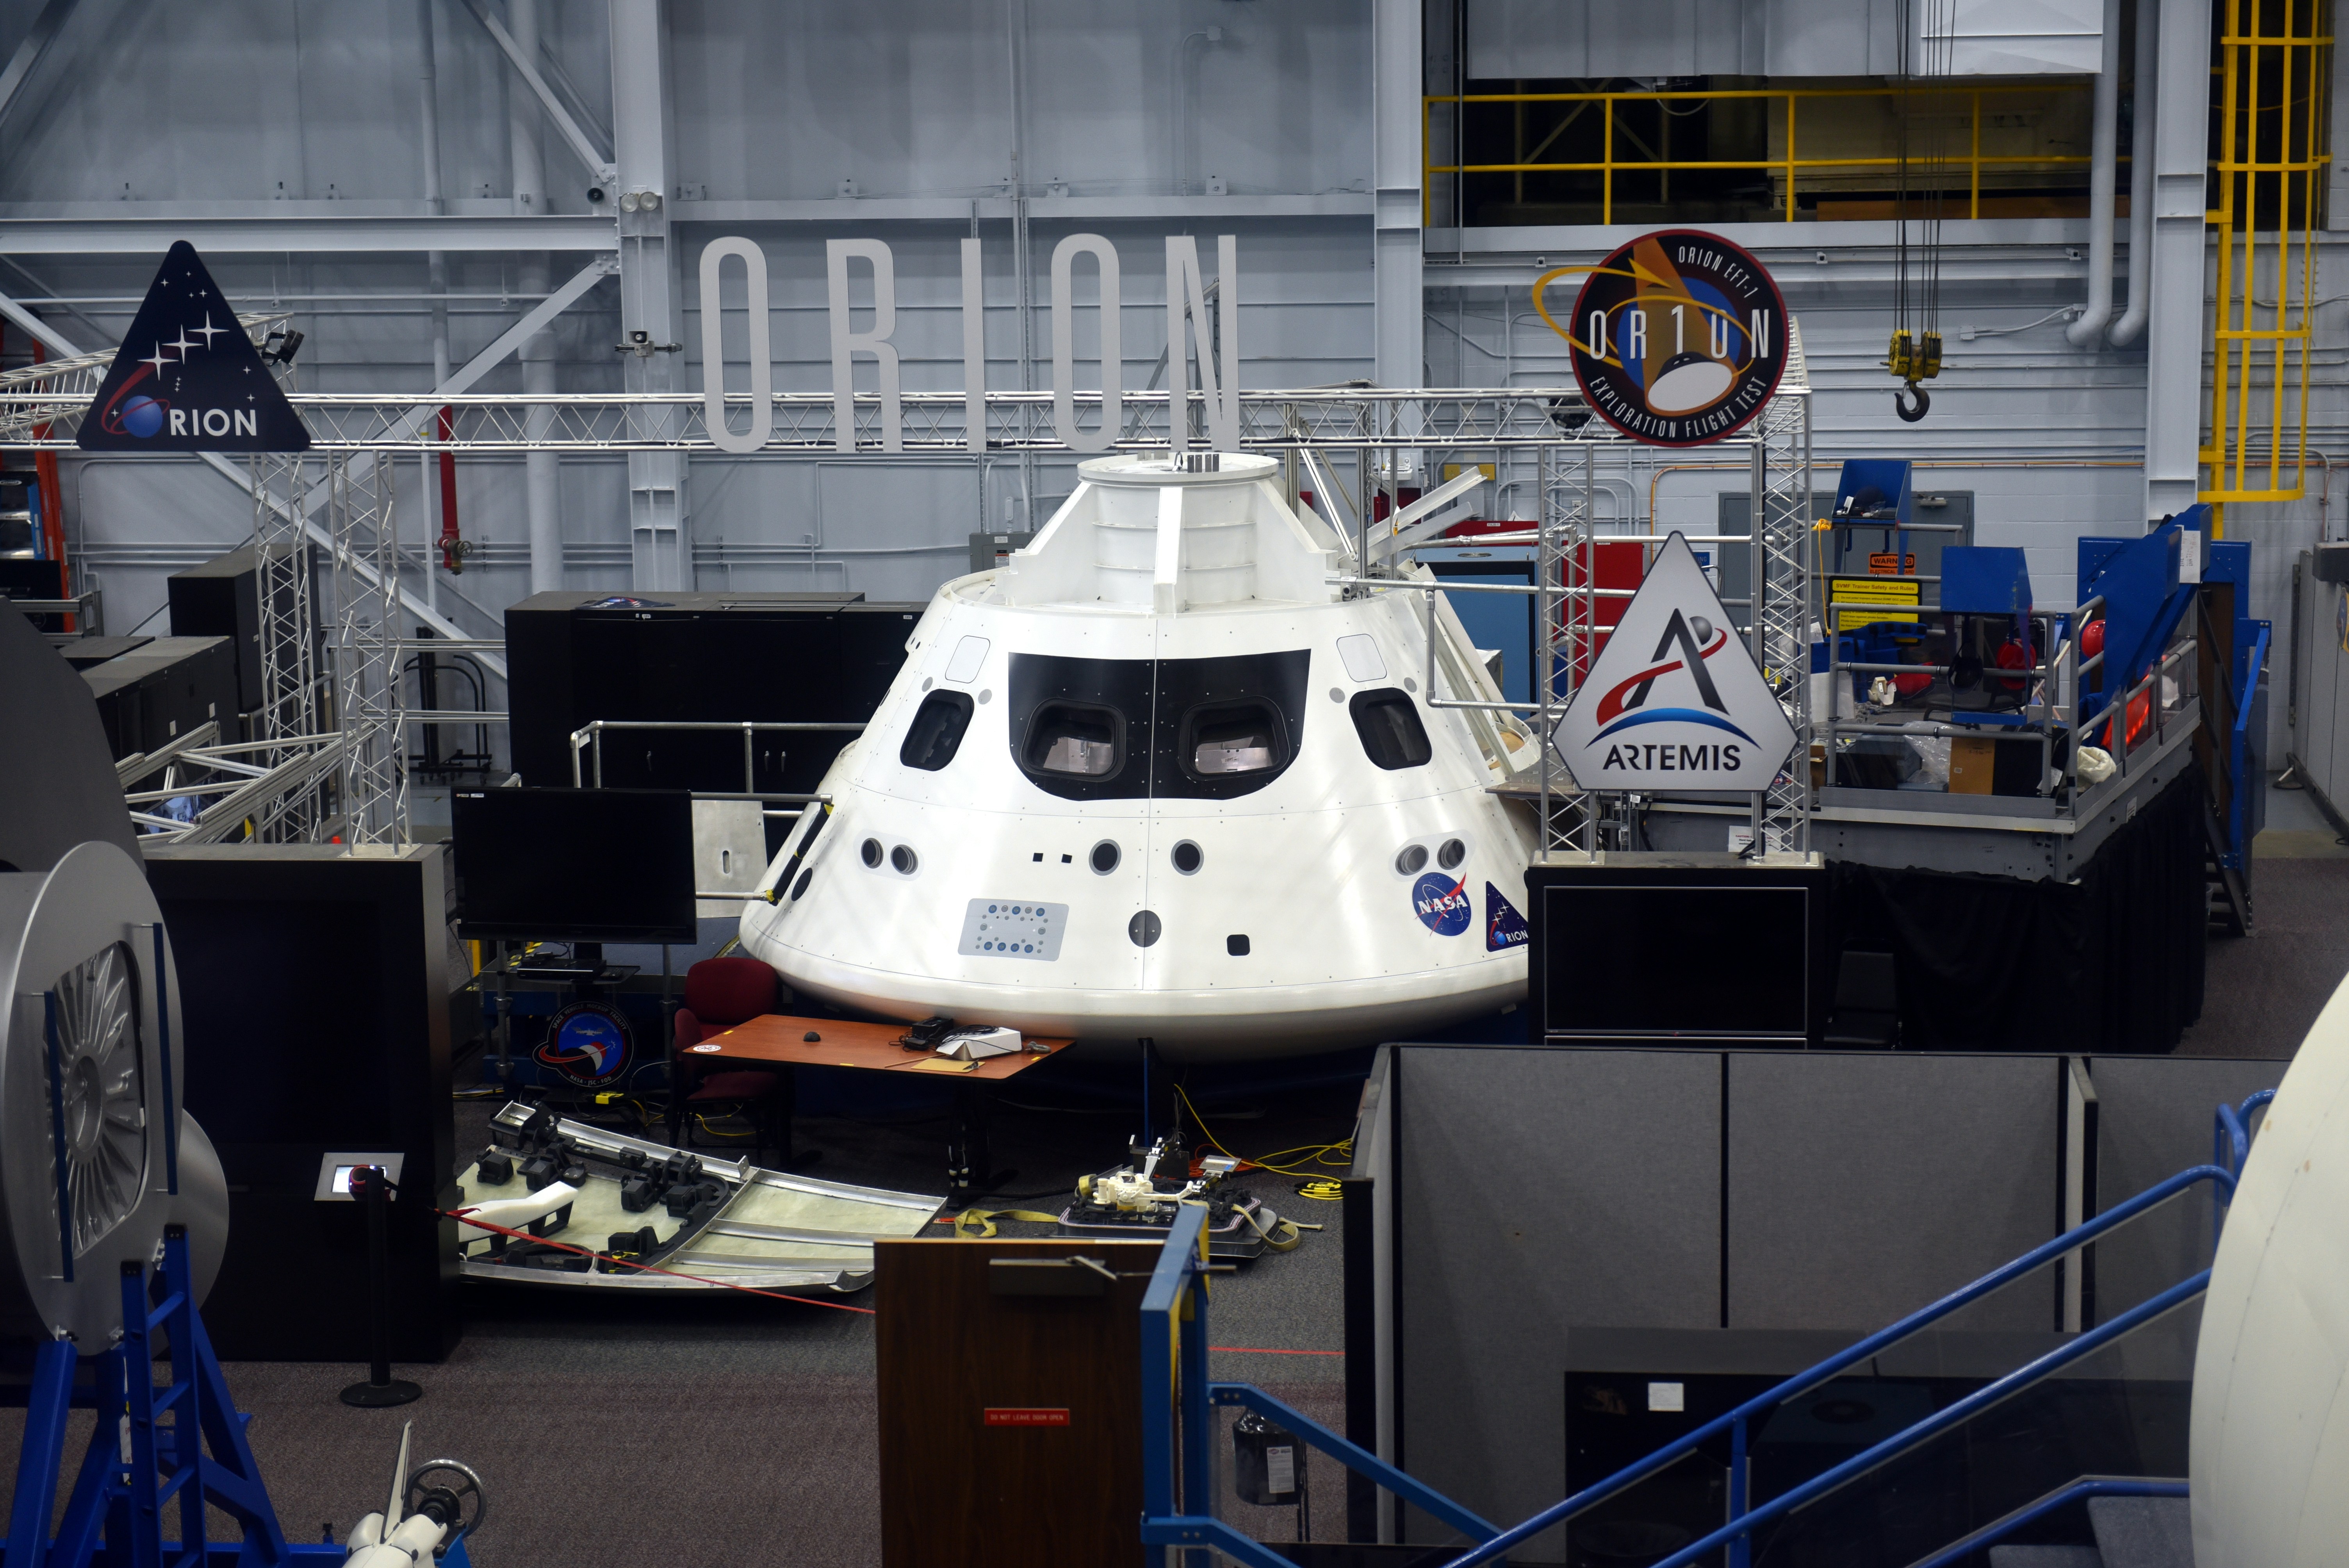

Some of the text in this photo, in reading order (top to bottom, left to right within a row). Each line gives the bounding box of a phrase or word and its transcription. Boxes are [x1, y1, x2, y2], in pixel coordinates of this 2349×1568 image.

[1679, 246, 1759, 298] ORION EFT-1
[699, 233, 1240, 453] ORION
[1590, 376, 1767, 438] EXPLORATION FLIGHT TEST
[1602, 744, 1741, 771] ARTEMIS
[1417, 894, 1468, 914] NASA
[552, 1003, 627, 1030] SPACE VEHICLE MOCKUP FACILITY
[570, 1074, 583, 1083] NASA
